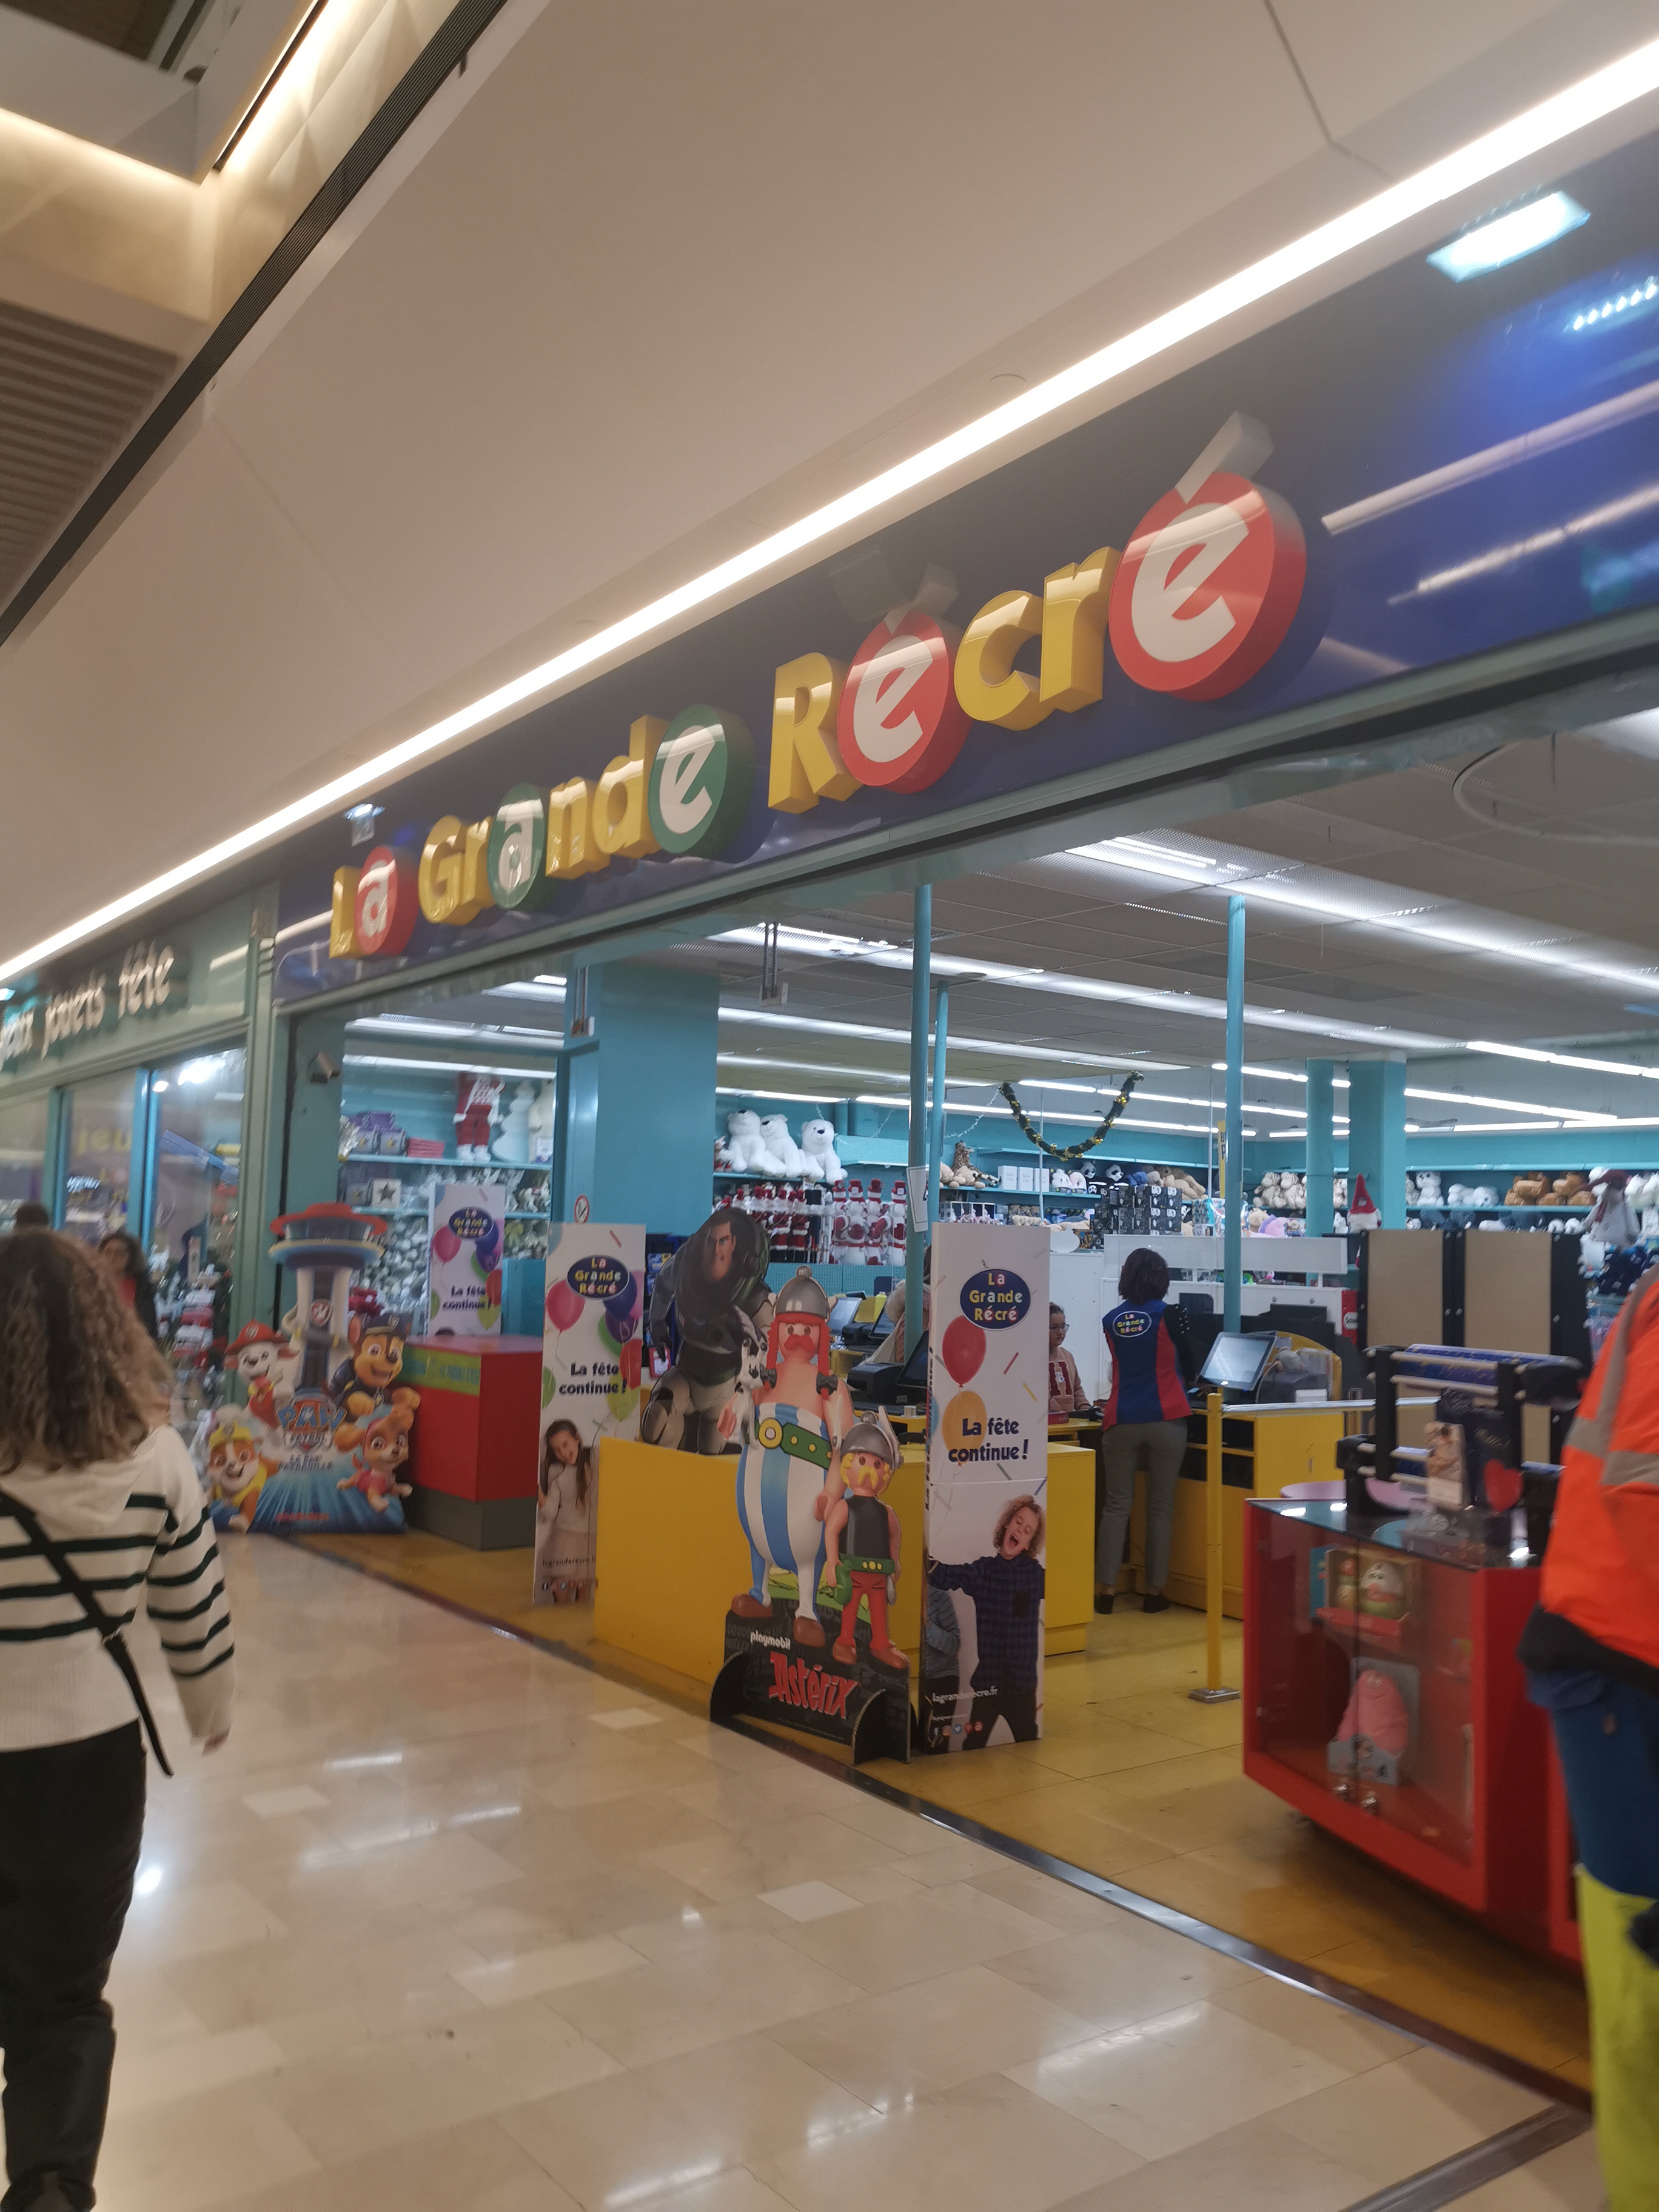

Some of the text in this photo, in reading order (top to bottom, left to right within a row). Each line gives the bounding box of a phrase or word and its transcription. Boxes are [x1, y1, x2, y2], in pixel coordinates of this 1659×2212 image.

[418, 705, 752, 926] Grande
[768, 411, 1306, 814] Récré
[575, 1269, 622, 1282] Grande
[987, 1272, 1007, 1287] La
[578, 1281, 617, 1295] Récré
[969, 1289, 1023, 1304] Grande
[974, 1304, 1019, 1322] Récré
[570, 1361, 619, 1377] La fête
[962, 1416, 1020, 1436] La fête
[749, 1630, 791, 1651] playmobil
[768, 1651, 859, 1720] Astérix
